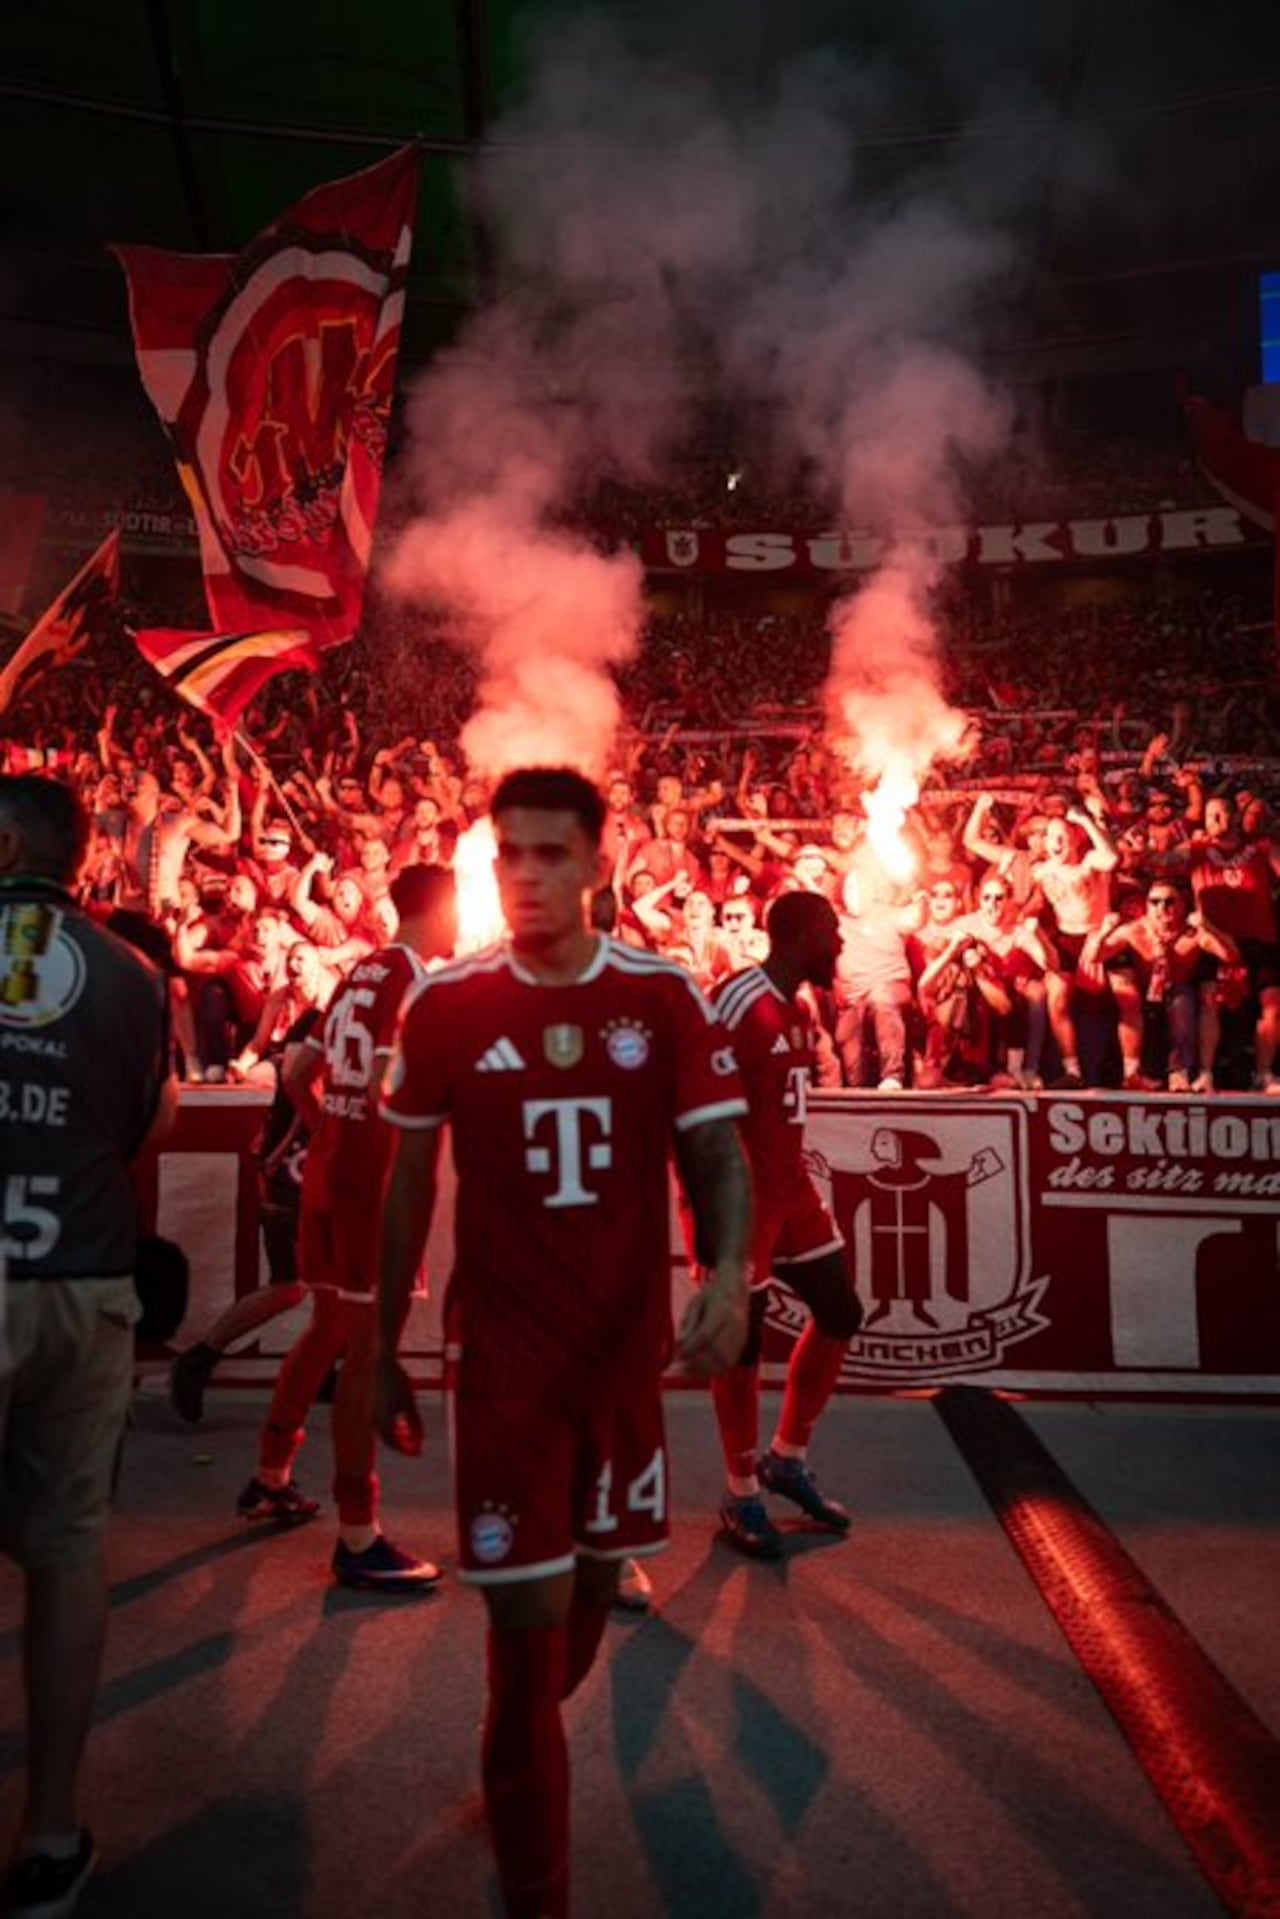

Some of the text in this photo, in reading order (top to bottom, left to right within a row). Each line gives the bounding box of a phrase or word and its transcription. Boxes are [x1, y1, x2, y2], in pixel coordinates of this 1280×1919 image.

[522, 1096, 612, 1208] T
[1047, 1102, 1280, 1160] Sektion
[1047, 1156, 1116, 1189] des
[586, 1447, 666, 1533] 14
